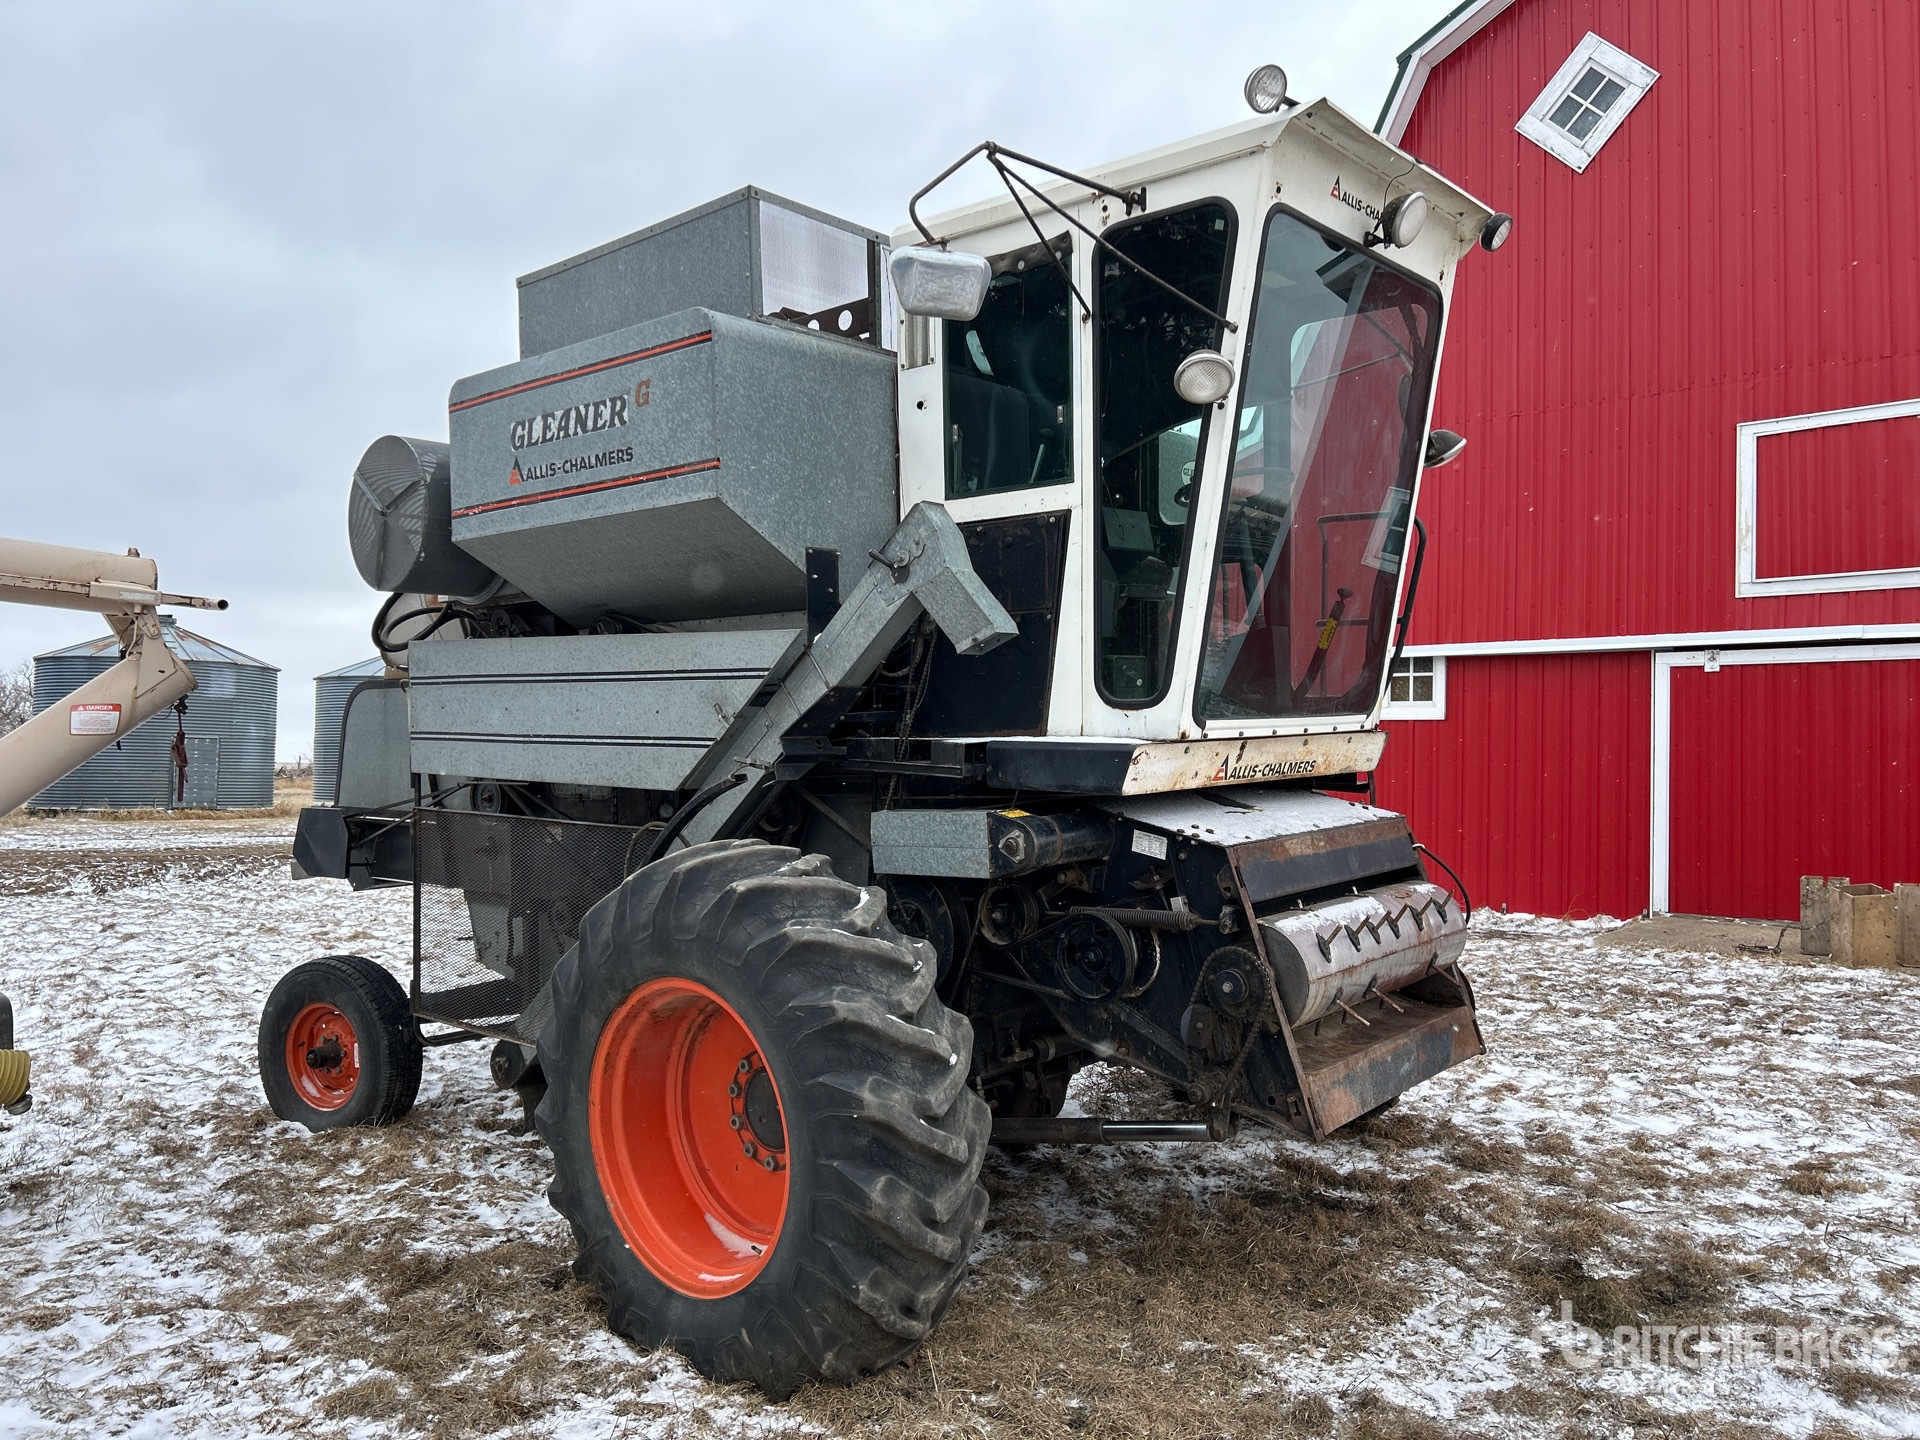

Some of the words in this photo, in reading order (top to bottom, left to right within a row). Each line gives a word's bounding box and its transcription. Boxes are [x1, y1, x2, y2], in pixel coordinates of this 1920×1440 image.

[511, 395, 628, 451] GLEANER
[635, 378, 651, 407] G
[525, 447, 633, 481] ALLIS-CHALMERS
[1229, 760, 1316, 780] ALLIS-CHALMERS
